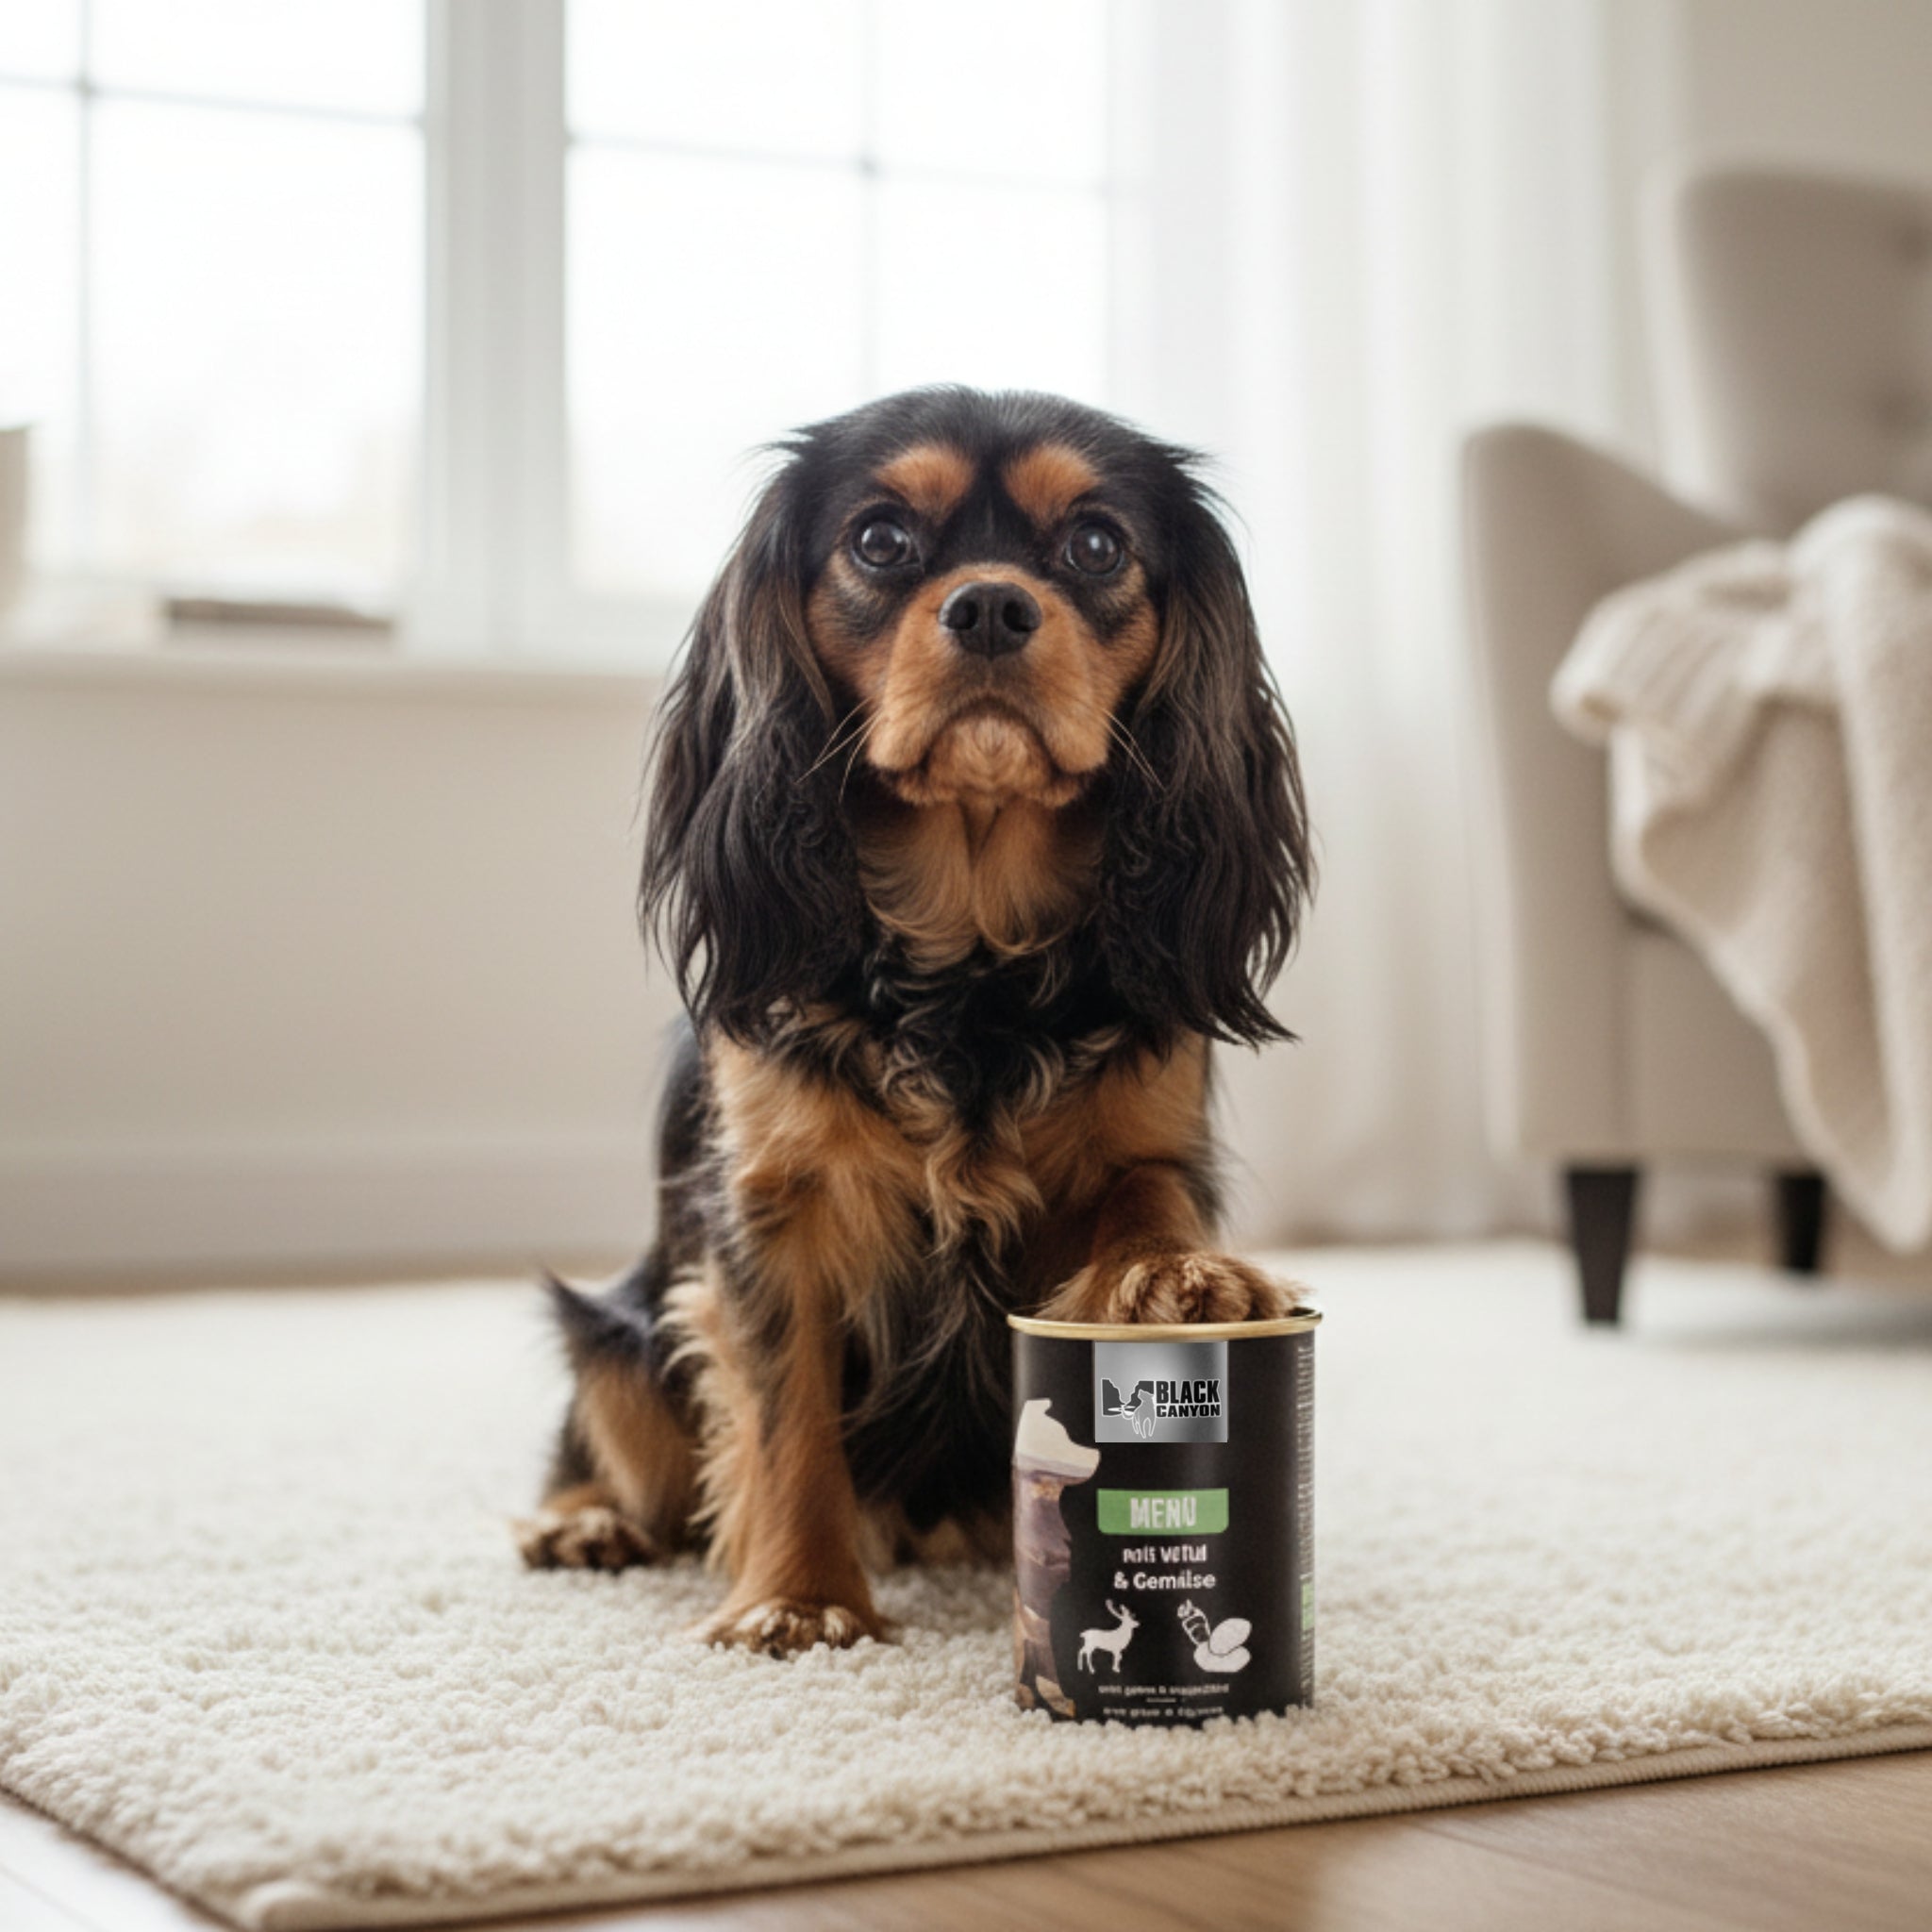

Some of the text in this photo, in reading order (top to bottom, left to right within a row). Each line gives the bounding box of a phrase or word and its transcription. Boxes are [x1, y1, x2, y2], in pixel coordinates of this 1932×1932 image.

[1156, 1379, 1220, 1404] BLACK
[1156, 1405, 1221, 1418] CANYON
[1114, 1571, 1129, 1590] &
